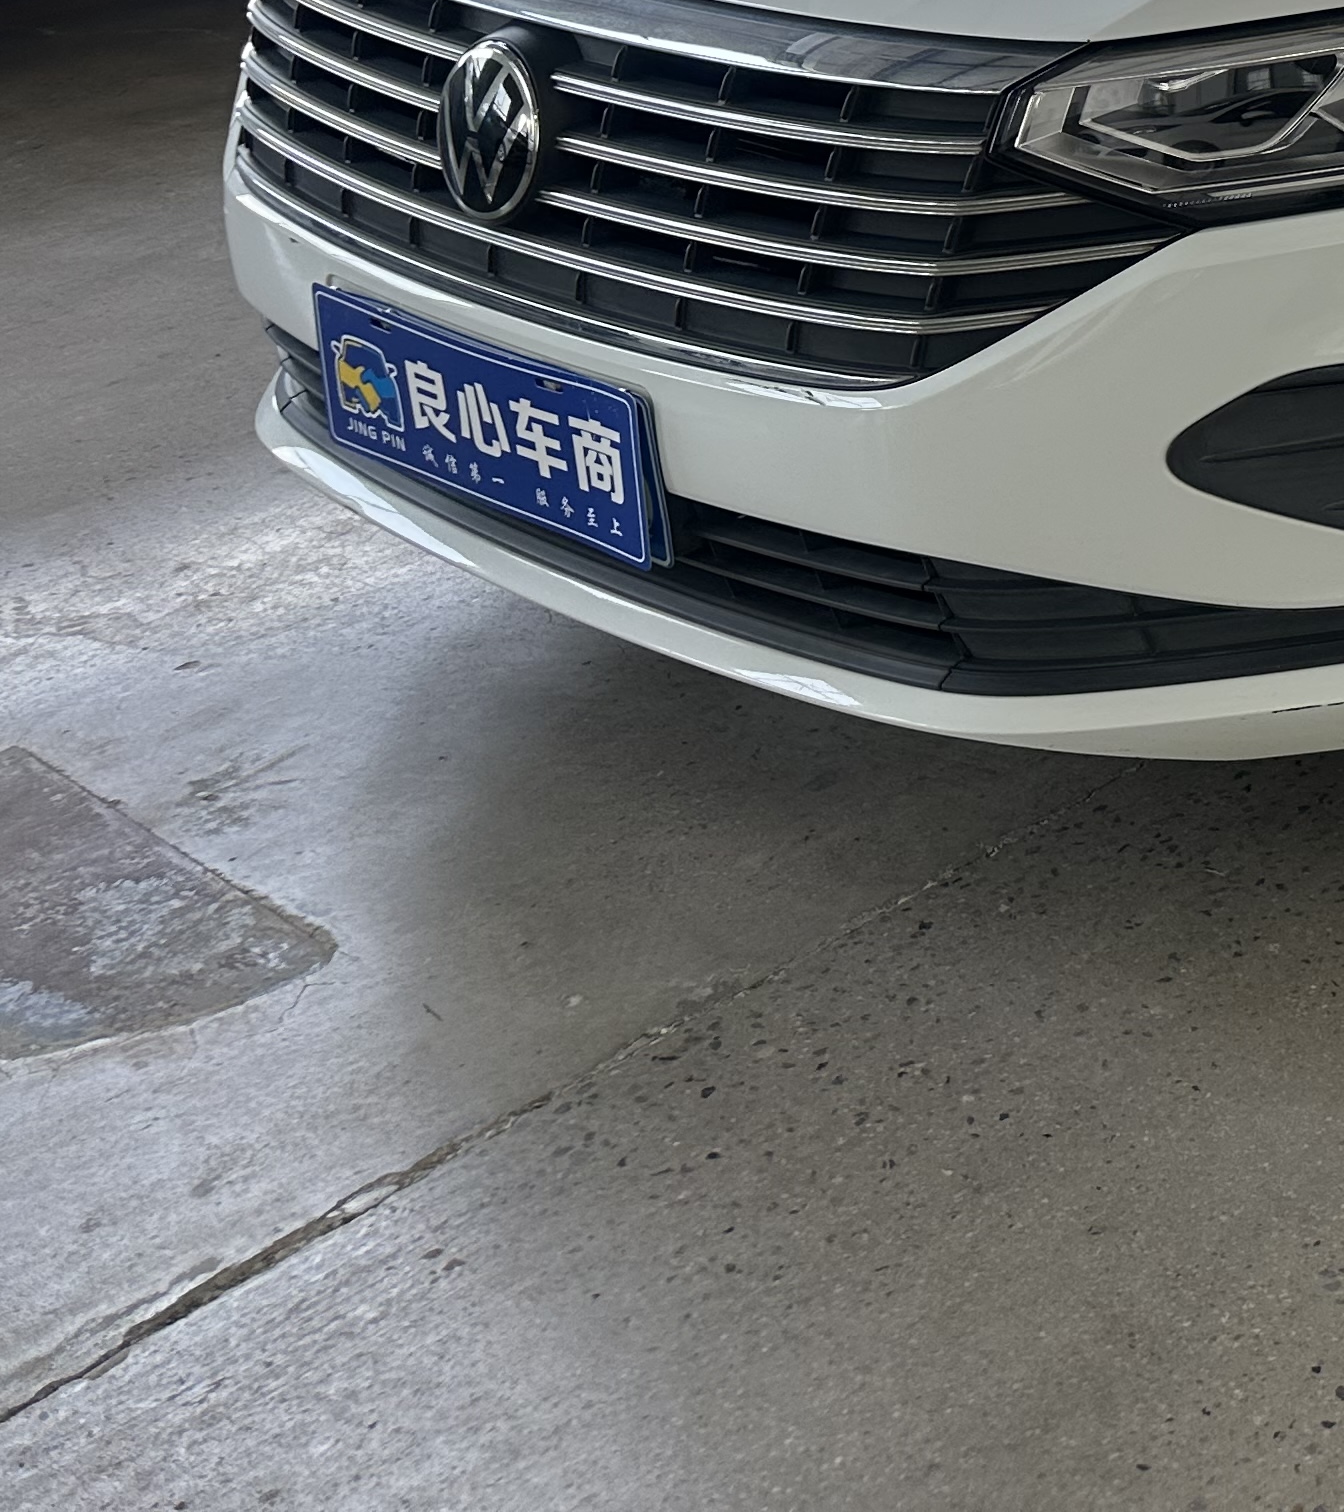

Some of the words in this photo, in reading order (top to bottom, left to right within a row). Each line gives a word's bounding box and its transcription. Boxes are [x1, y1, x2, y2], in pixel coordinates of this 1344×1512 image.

[439, 40, 539, 220] VW
[347, 417, 378, 440] JING
[381, 430, 406, 452] PIN
[404, 359, 625, 505] 良心车商
[535, 487, 623, 537] 服务至上
